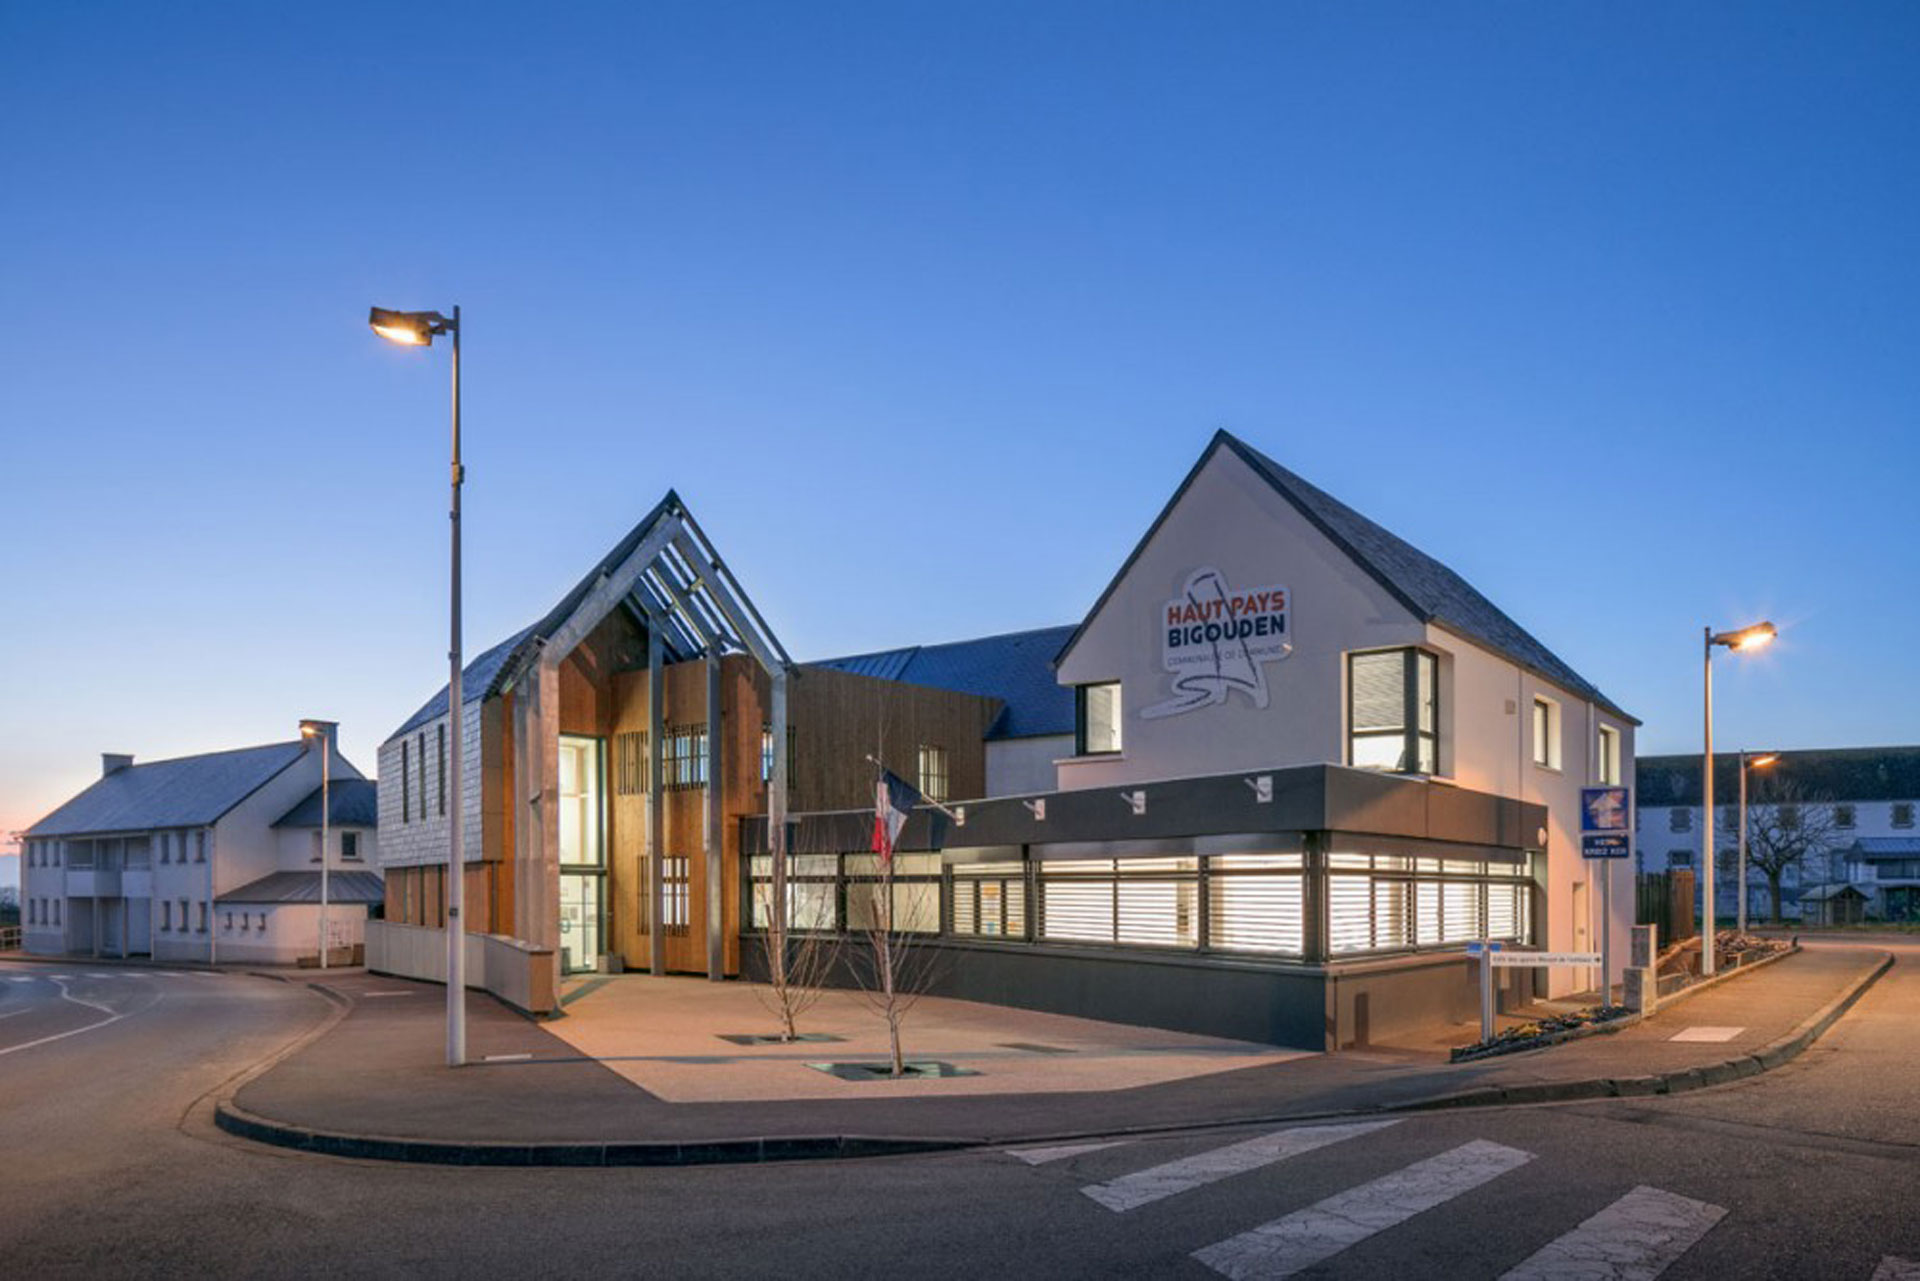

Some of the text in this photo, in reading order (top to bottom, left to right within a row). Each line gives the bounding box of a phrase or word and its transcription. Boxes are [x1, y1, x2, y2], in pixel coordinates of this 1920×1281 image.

[1167, 591, 1285, 625] HAUT PAYS
[1168, 614, 1285, 648] BIGOUDEN
